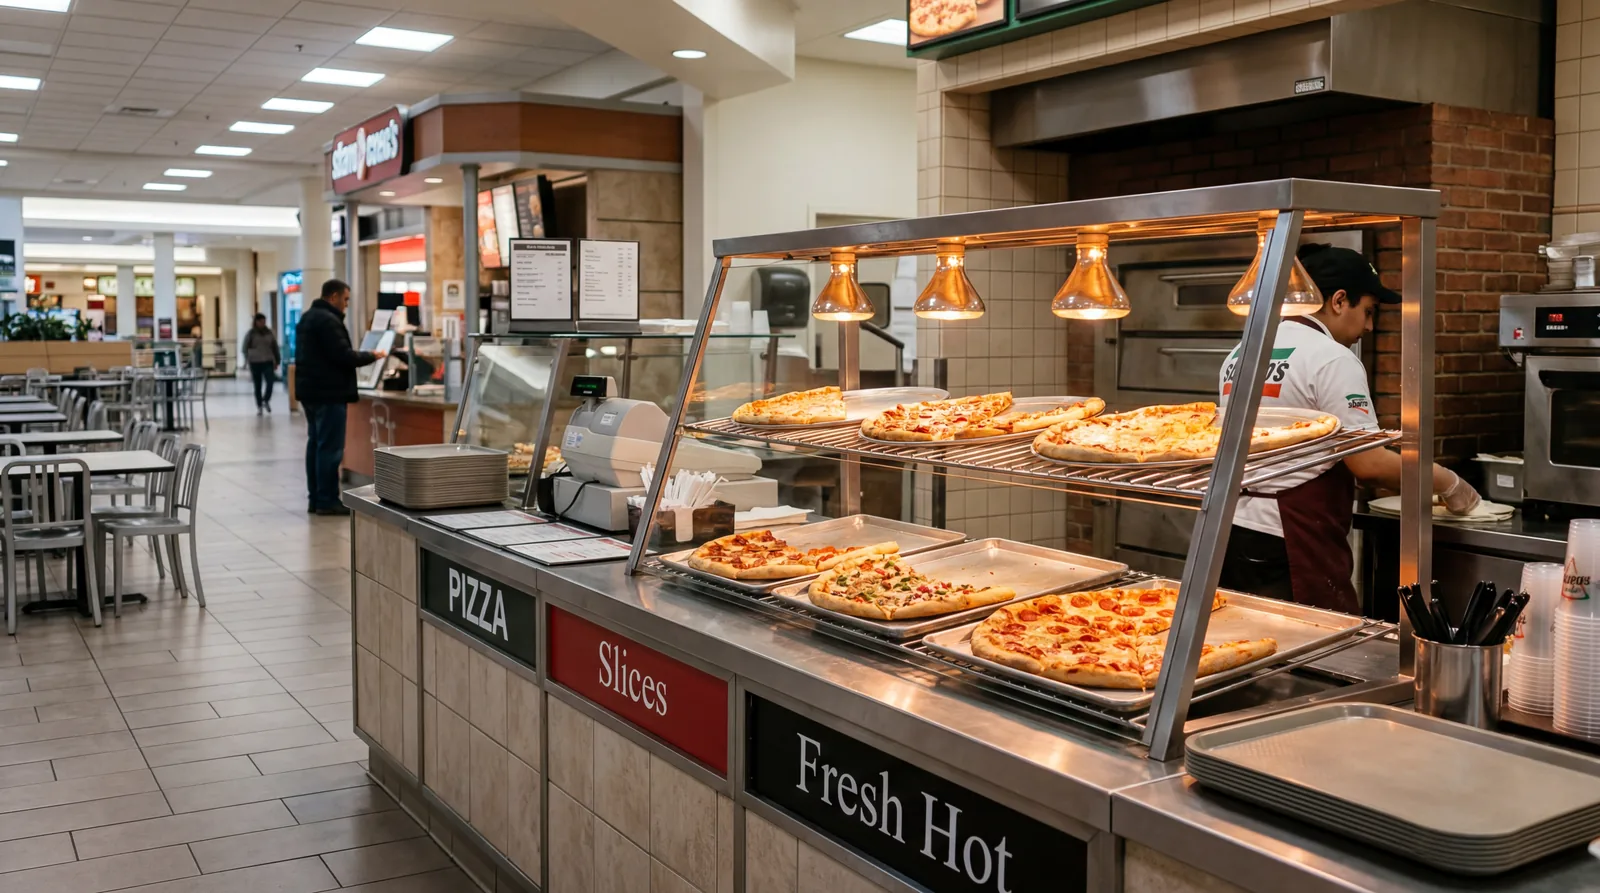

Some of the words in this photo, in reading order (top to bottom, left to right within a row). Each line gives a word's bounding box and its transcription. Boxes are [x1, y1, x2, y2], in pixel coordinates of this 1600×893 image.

[448, 566, 509, 642] PIZZA
[598, 640, 669, 717] Slices
[796, 732, 906, 844] Fresh
[920, 791, 1013, 893] Hot
